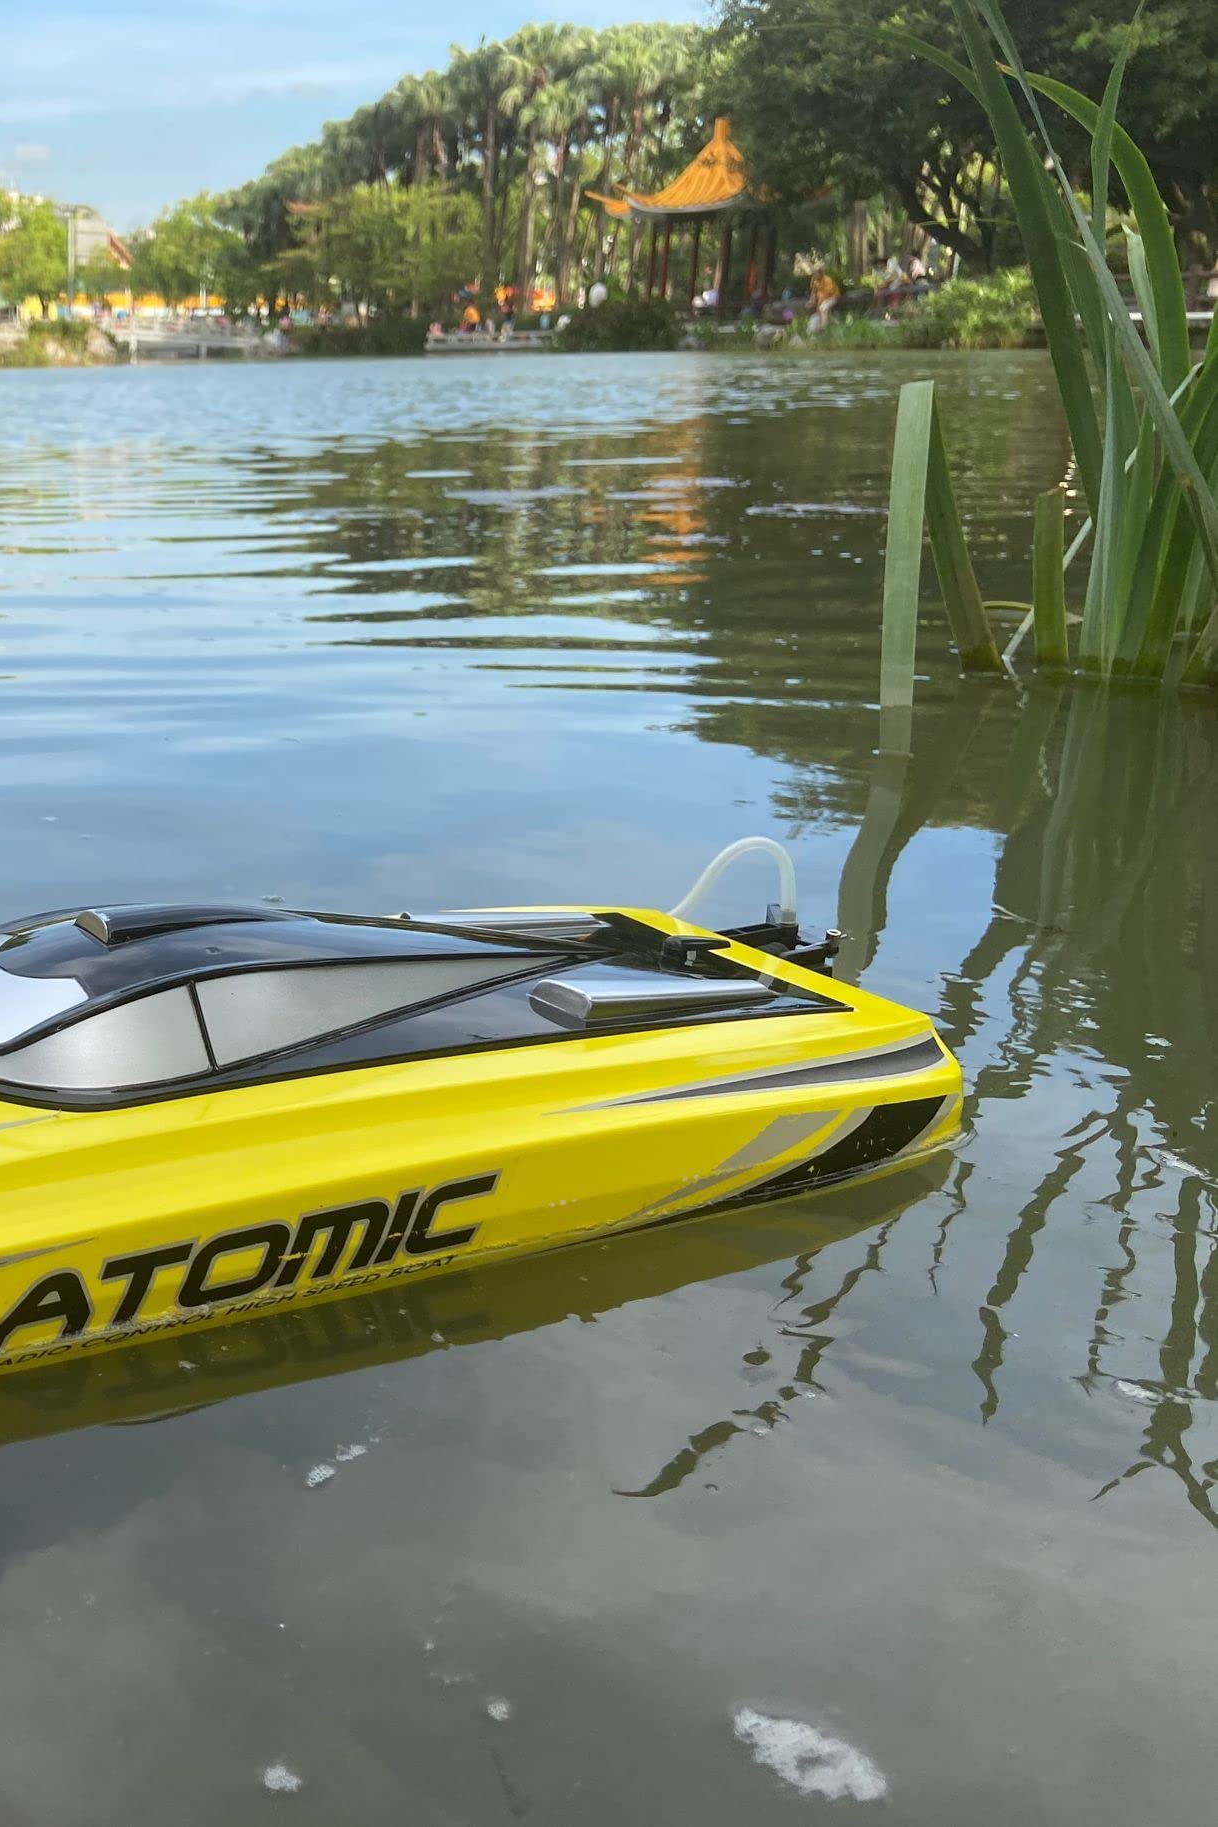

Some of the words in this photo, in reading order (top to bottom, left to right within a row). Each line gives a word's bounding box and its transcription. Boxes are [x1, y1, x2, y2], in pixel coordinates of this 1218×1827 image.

[225, 1291, 297, 1316] HIGH
[302, 1273, 382, 1298] SPEED
[387, 1254, 459, 1279] BOAT
